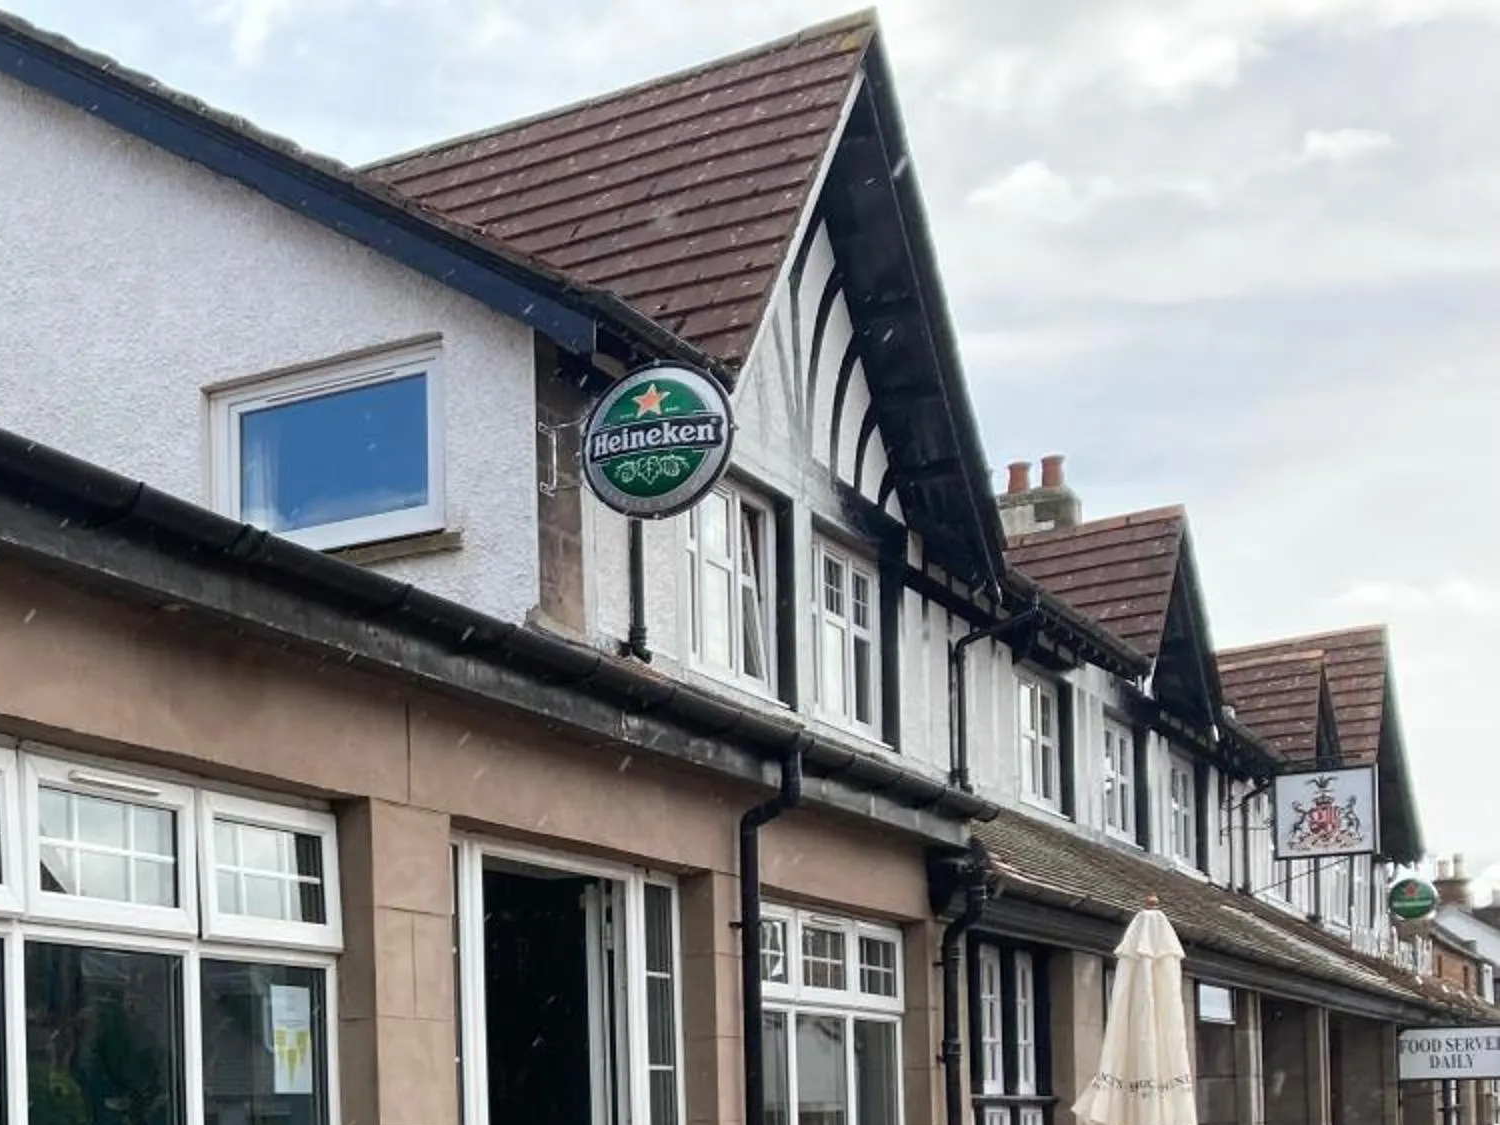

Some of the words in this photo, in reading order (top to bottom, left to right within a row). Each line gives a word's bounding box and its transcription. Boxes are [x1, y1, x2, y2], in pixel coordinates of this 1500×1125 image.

[593, 421, 715, 458] Heineken
[1400, 1038, 1442, 1054] FOOD
[1430, 1053, 1474, 1069] DAILY
